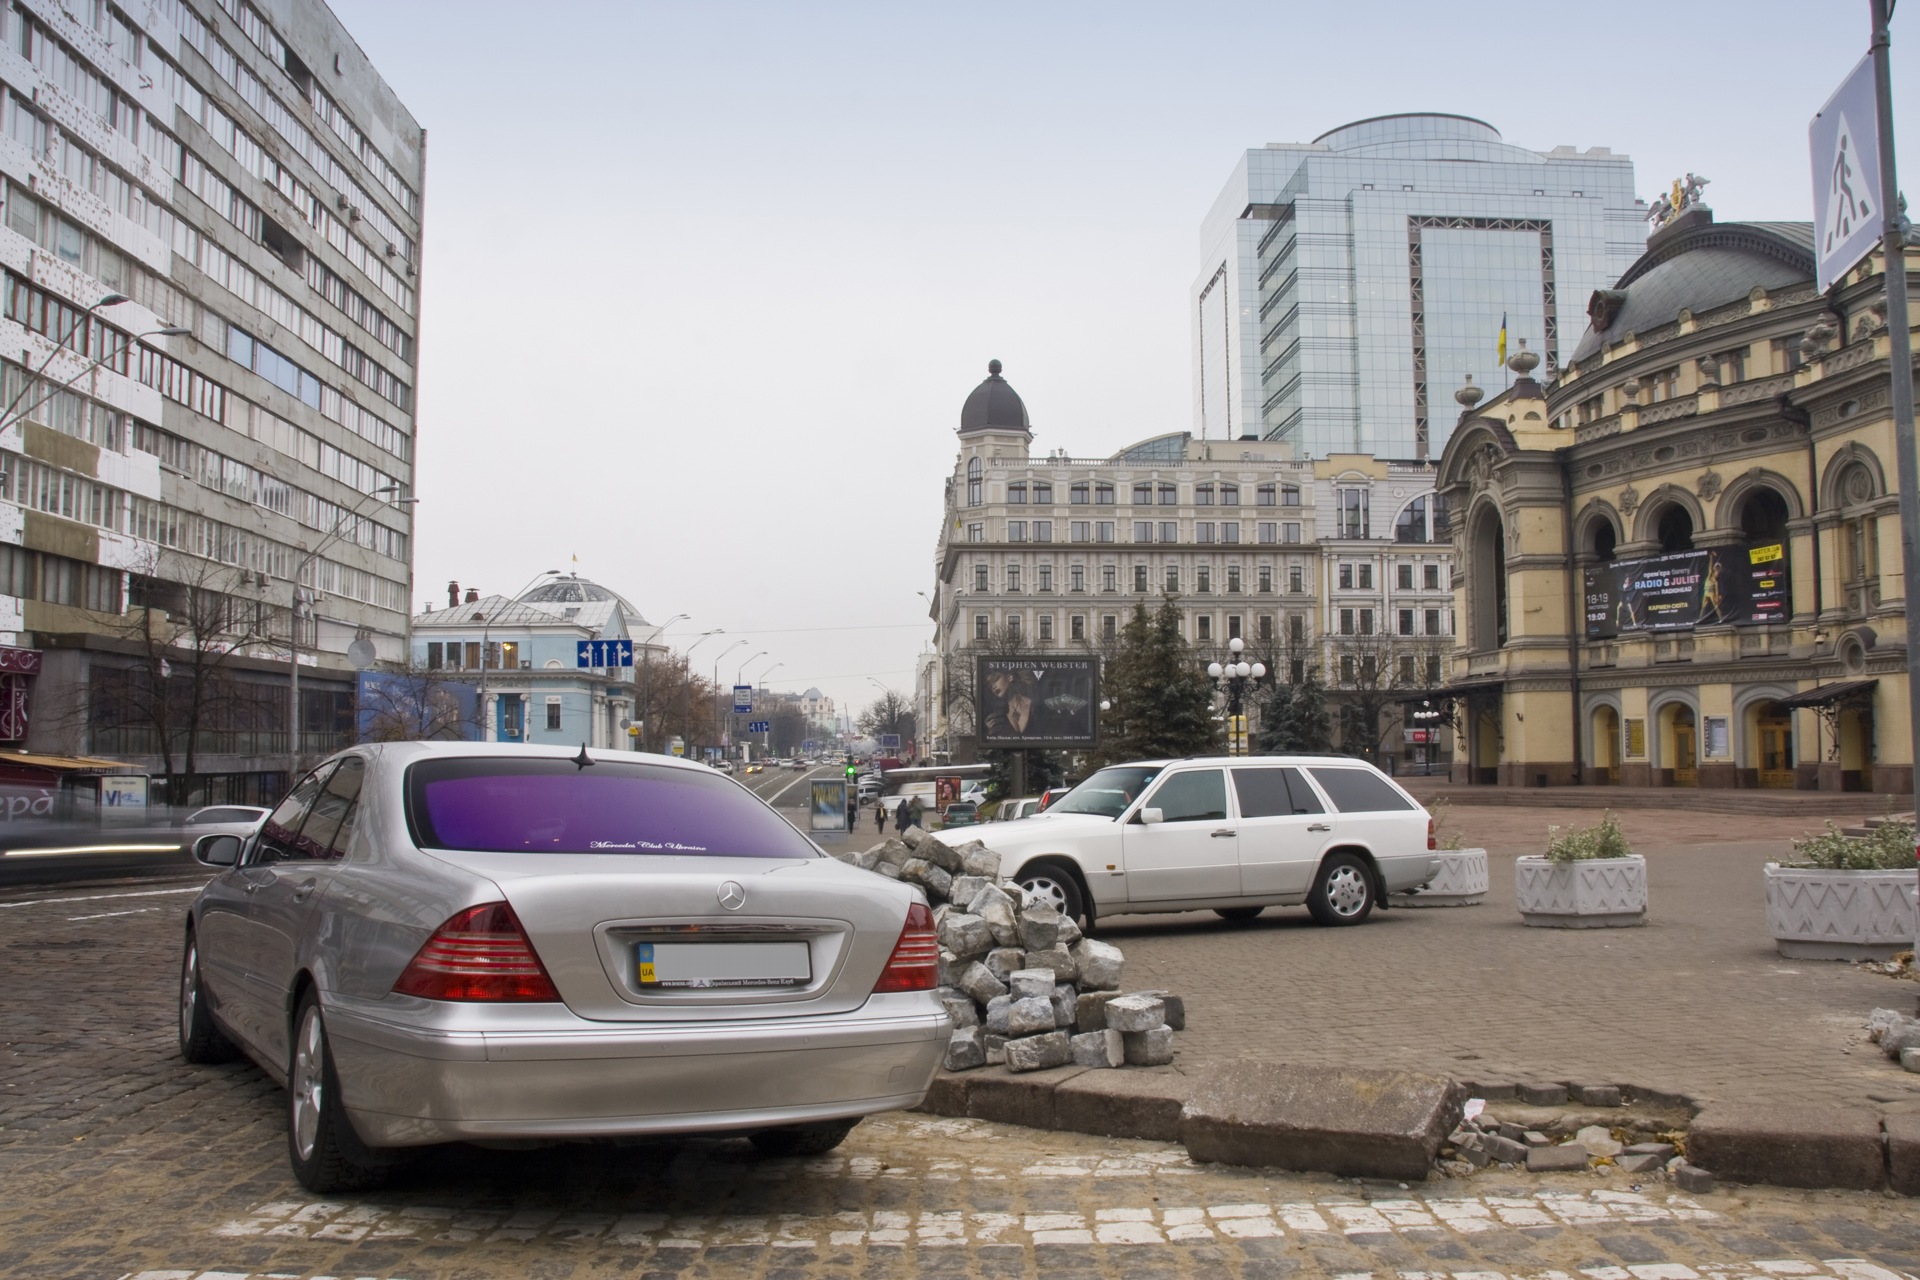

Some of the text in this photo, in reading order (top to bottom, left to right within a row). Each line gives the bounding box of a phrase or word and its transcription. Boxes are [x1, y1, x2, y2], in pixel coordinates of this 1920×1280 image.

[1634, 574, 1700, 590] RADIO & JULIET
[1661, 586, 1692, 595] RADIOHEAD
[1586, 593, 1609, 604] 18-19
[1587, 612, 1606, 621] 19:00
[989, 661, 1088, 670] STEPHEN WEBSTER
[590, 841, 707, 851] Mercedes Club Ukraine
[642, 968, 654, 976] UA
